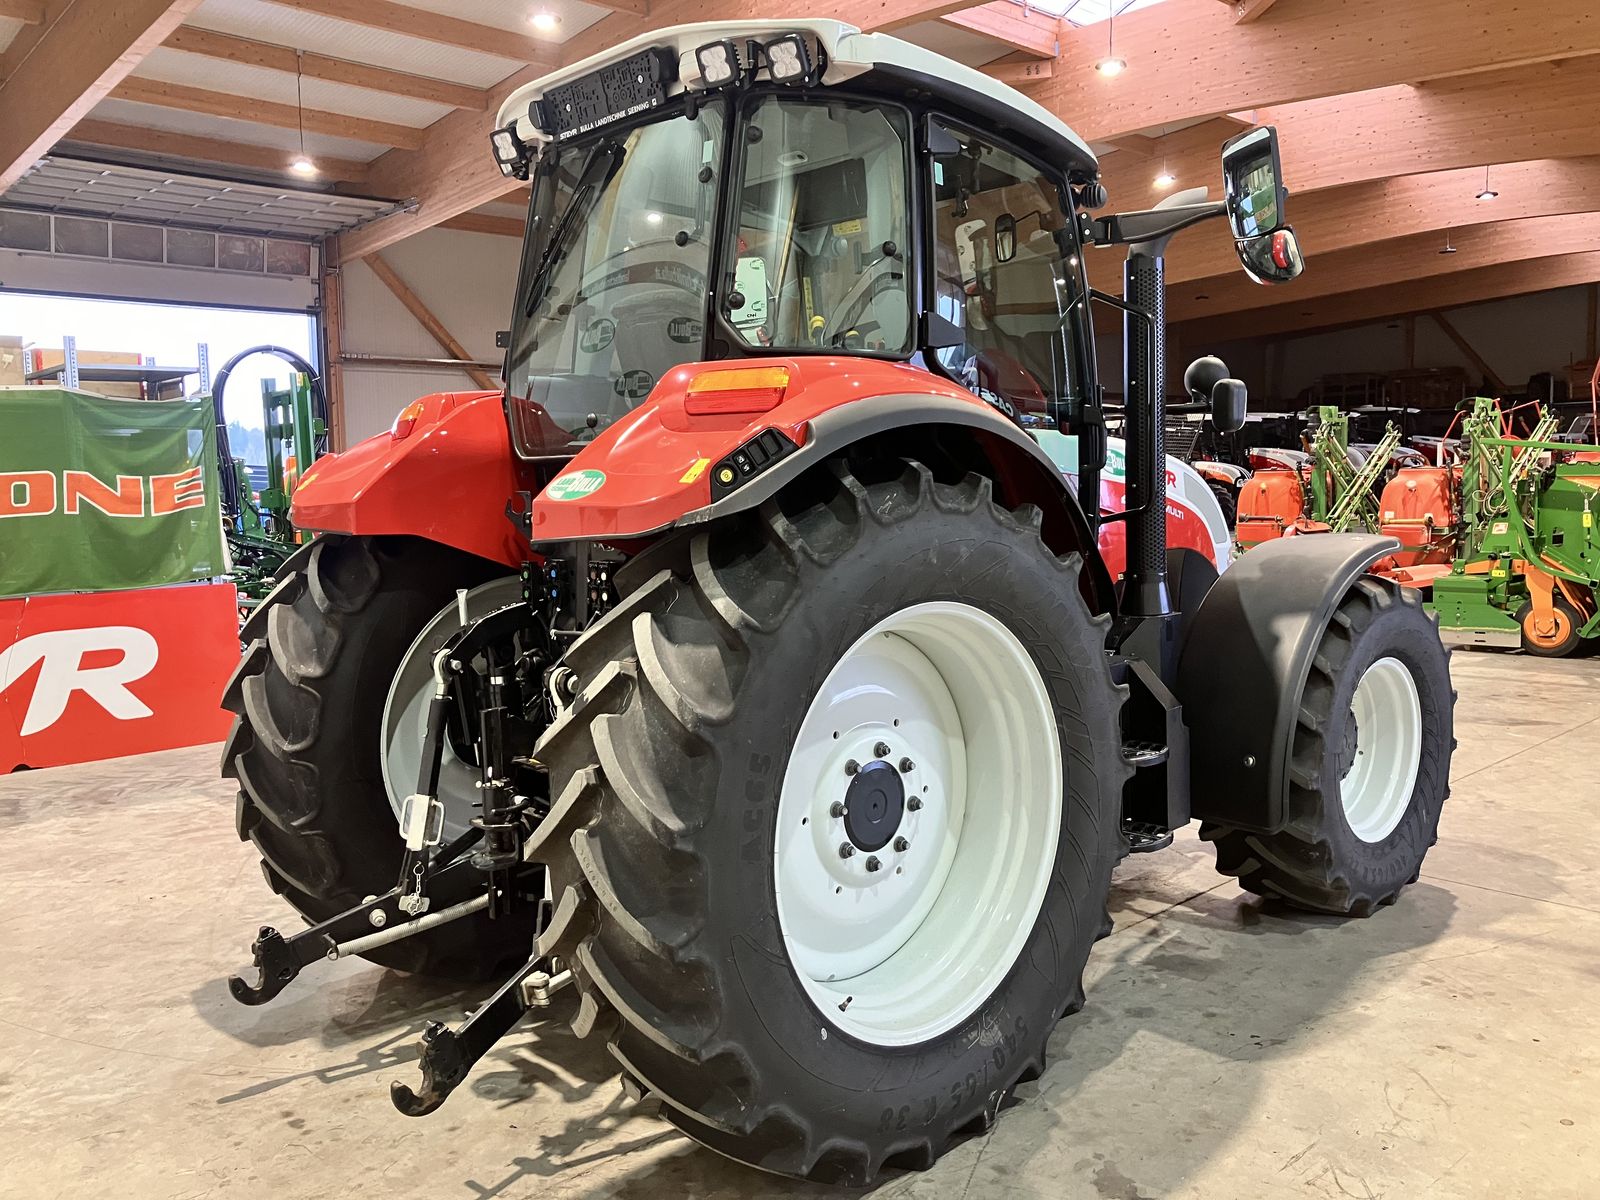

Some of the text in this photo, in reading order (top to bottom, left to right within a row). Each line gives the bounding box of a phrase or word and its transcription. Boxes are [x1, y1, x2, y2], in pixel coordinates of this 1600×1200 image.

[560, 128, 578, 141] STEYR
[580, 122, 595, 133] BULLA
[595, 110, 627, 128] LANDTECHNIK
